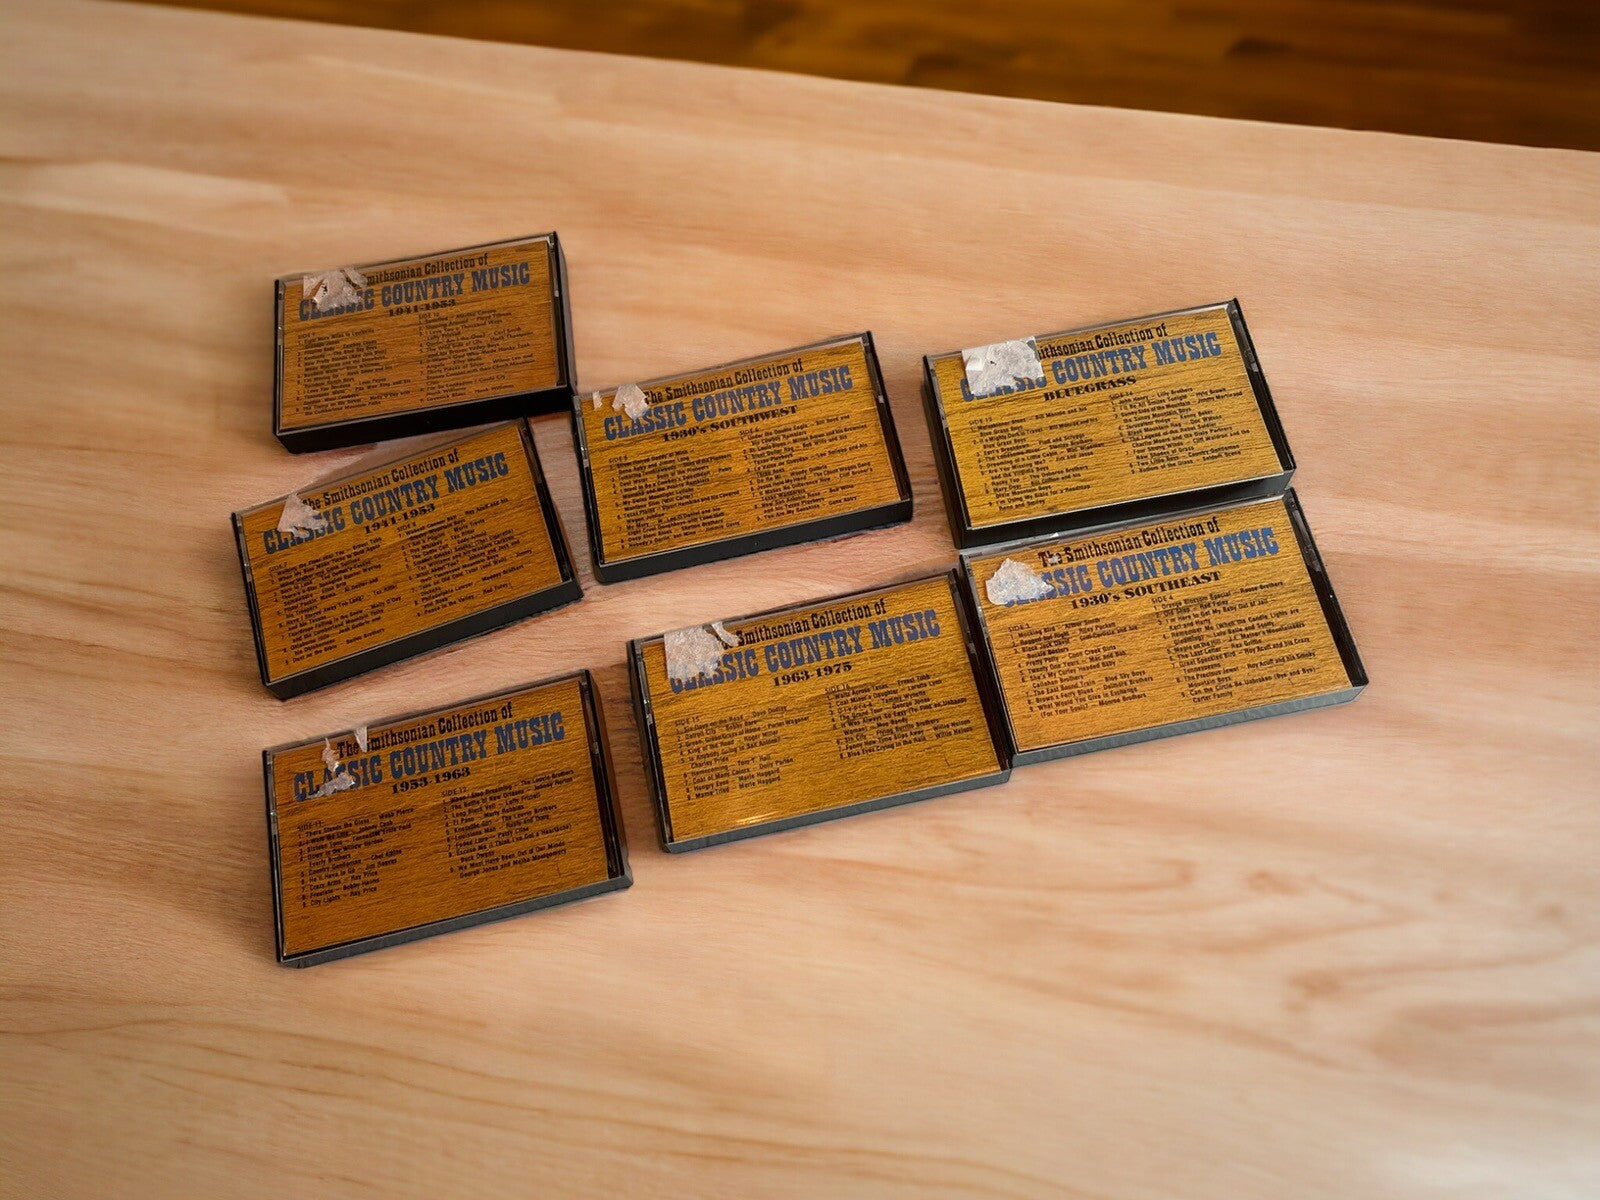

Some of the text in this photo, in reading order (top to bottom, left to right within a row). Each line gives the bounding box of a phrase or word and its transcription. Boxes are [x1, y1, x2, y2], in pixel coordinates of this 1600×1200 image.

[362, 265, 422, 286] mithsonian
[424, 257, 474, 275] Collection
[478, 252, 488, 265] of
[381, 272, 465, 307] COUNTRY
[471, 261, 529, 292] MUSIC
[1034, 322, 1169, 359] ithsonian Collection of
[1050, 345, 1151, 385] COUNTRY
[1150, 331, 1223, 366] MUSIC
[664, 375, 733, 400] Smithsonian
[733, 363, 790, 385] Collection
[791, 357, 804, 372] of
[1042, 375, 1137, 401] BLUEGRASS
[602, 364, 854, 441] CLASSIC COUNTRY MUSIC
[708, 404, 798, 431] SOUTHWEST
[322, 474, 390, 506] Smithsonian
[390, 455, 446, 483] Collection
[448, 447, 460, 463] of
[349, 473, 442, 525] COUNTRY
[443, 451, 509, 494] MUSIC
[363, 502, 436, 534] 1941-1953
[1063, 535, 1142, 561] Smithsonian
[1141, 522, 1205, 546] Collection
[1206, 516, 1221, 533] of
[1095, 542, 1203, 588] COUNTRY
[1202, 526, 1281, 566] MUSIC
[1070, 570, 1223, 609] 1930's SOUTHEAST
[735, 618, 810, 647] Smithsonian
[810, 604, 872, 629] Collection
[873, 597, 887, 615] of
[762, 624, 866, 673] COUNTRY
[867, 608, 942, 650] MUSIC
[771, 660, 853, 687] 1963-1975
[336, 700, 513, 759] The mithsonian Collection of
[388, 728, 489, 780] COUNTRY
[494, 710, 565, 755] MUSIC
[390, 766, 471, 795] 1953-1963
